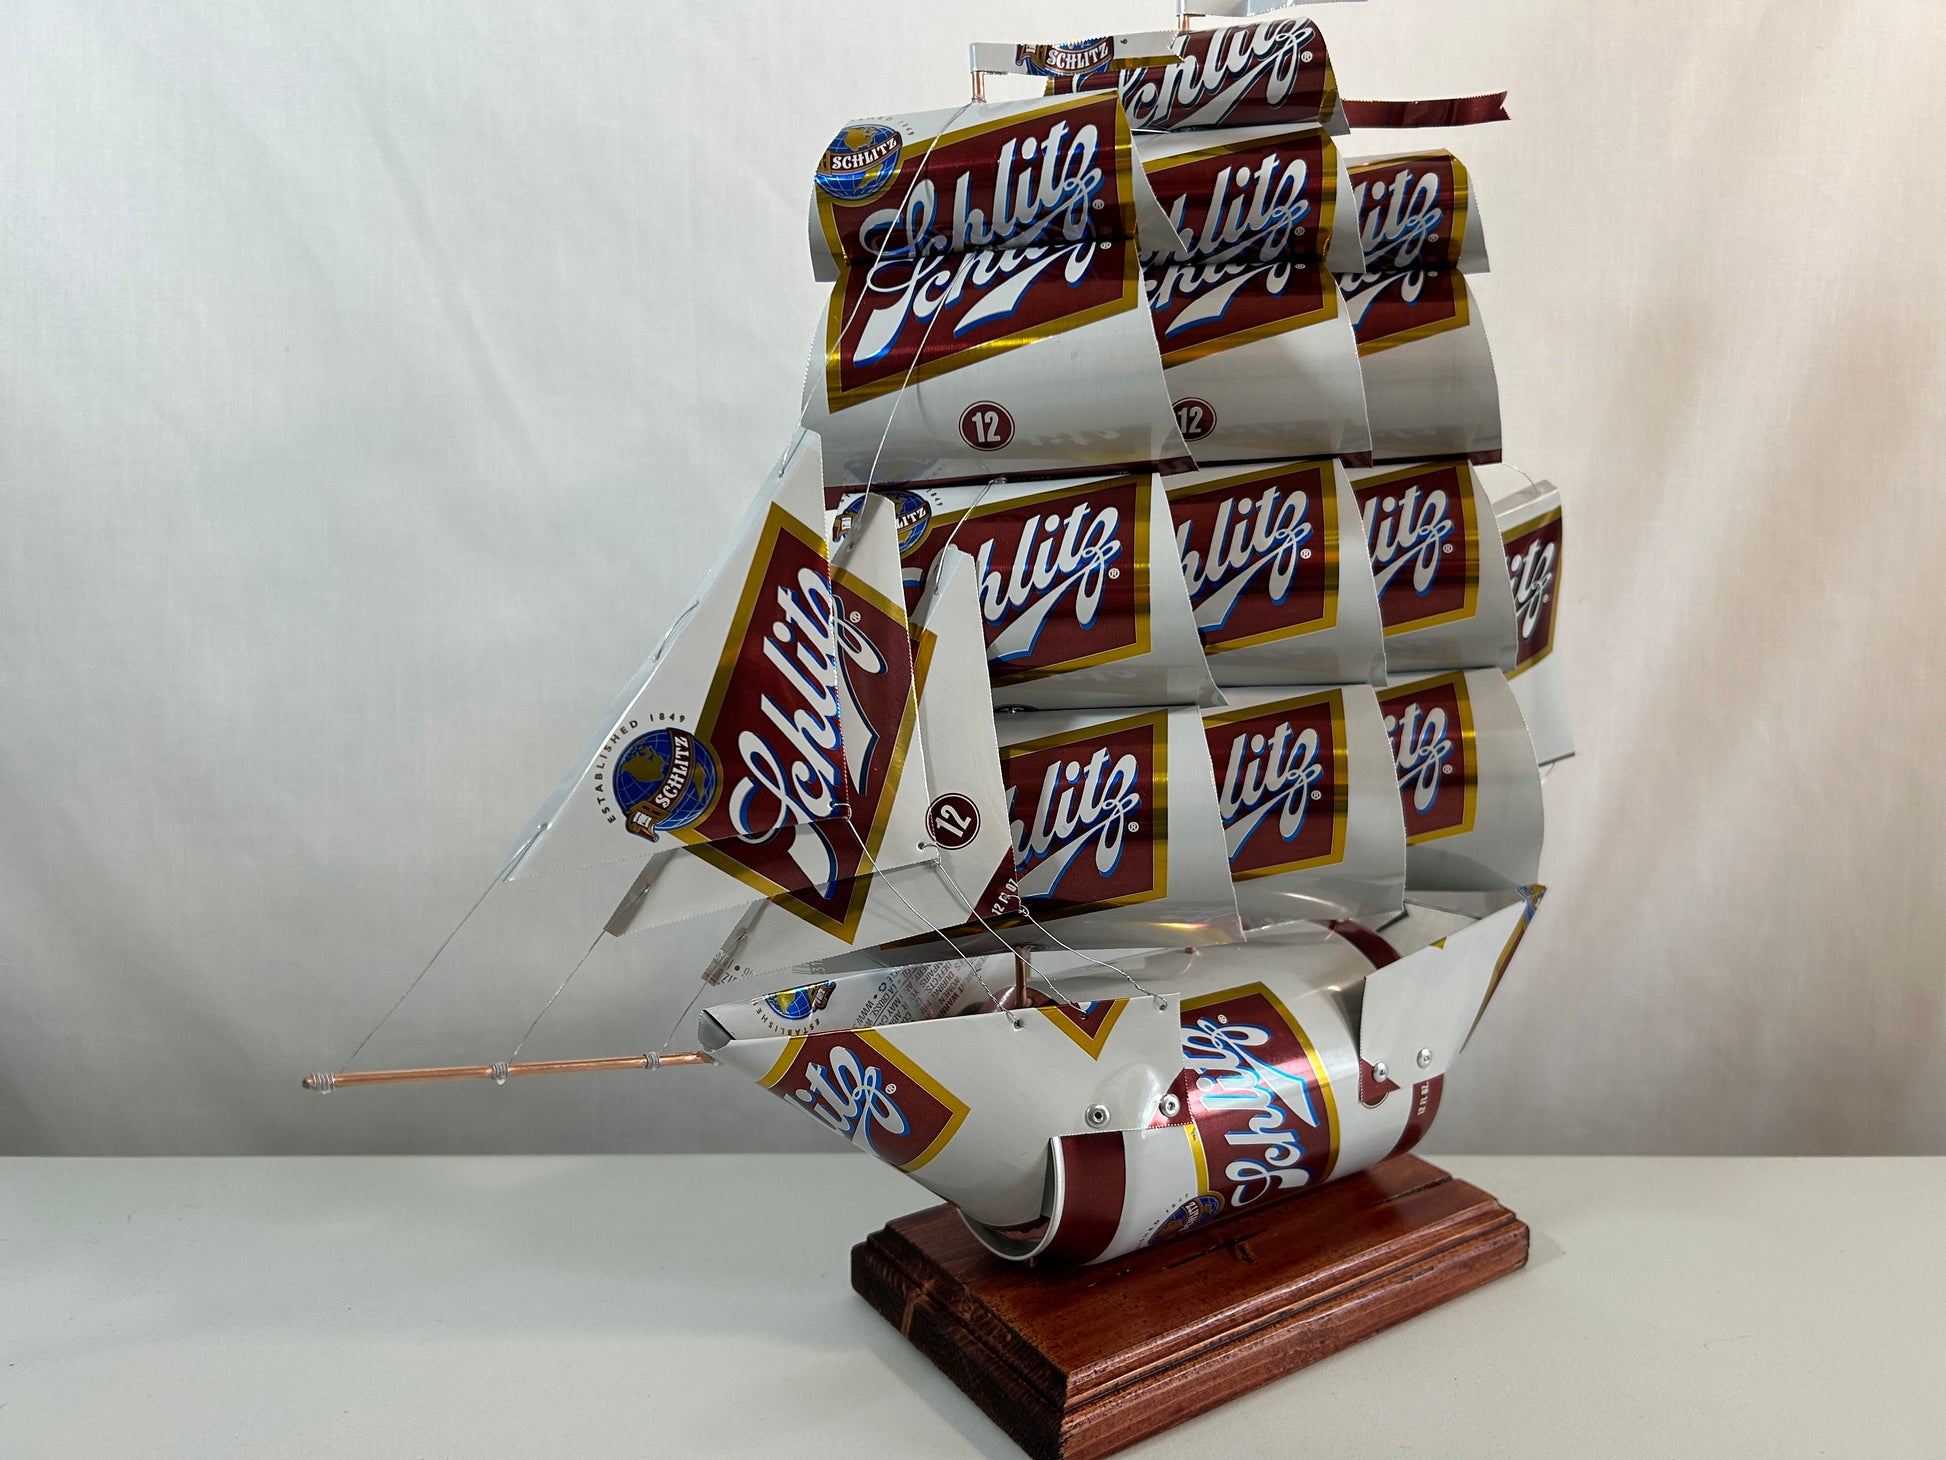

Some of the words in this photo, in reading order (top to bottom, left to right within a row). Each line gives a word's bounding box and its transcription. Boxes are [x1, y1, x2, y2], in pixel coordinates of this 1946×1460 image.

[1046, 42, 1109, 69] SCHLITZ
[832, 138, 897, 170] SCHLITZ
[971, 411, 1001, 443] 12
[1177, 406, 1203, 434] 12
[594, 719, 640, 825] ESTABLISHED
[648, 712, 686, 723] 1849
[655, 735, 690, 810] SCHLITZ
[935, 804, 972, 838] 12
[991, 902, 1005, 916] 12
